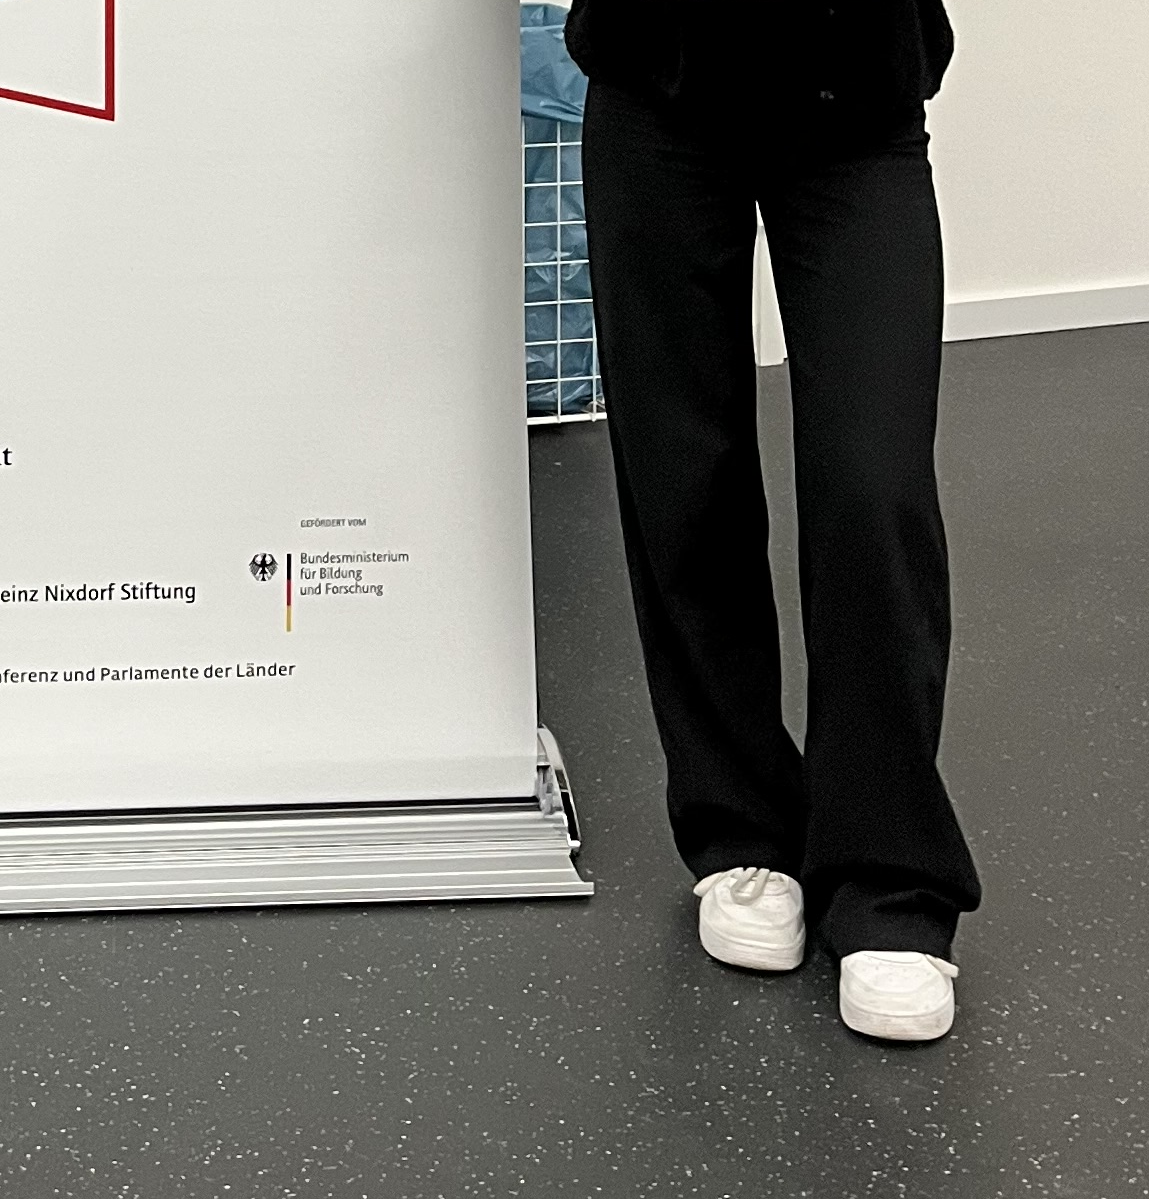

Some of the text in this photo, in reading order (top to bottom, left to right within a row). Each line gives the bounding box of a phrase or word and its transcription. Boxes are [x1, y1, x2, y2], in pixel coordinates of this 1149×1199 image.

[301, 552, 409, 564] Bundesministerium
[301, 567, 362, 581] für Bildung
[46, 583, 115, 601] Nixdorf
[121, 582, 195, 603] Stiftung
[300, 582, 383, 596] und Forschung
[64, 668, 95, 681] und
[101, 667, 198, 681] Parlamente
[204, 665, 232, 678] der
[237, 663, 296, 677] Länder
